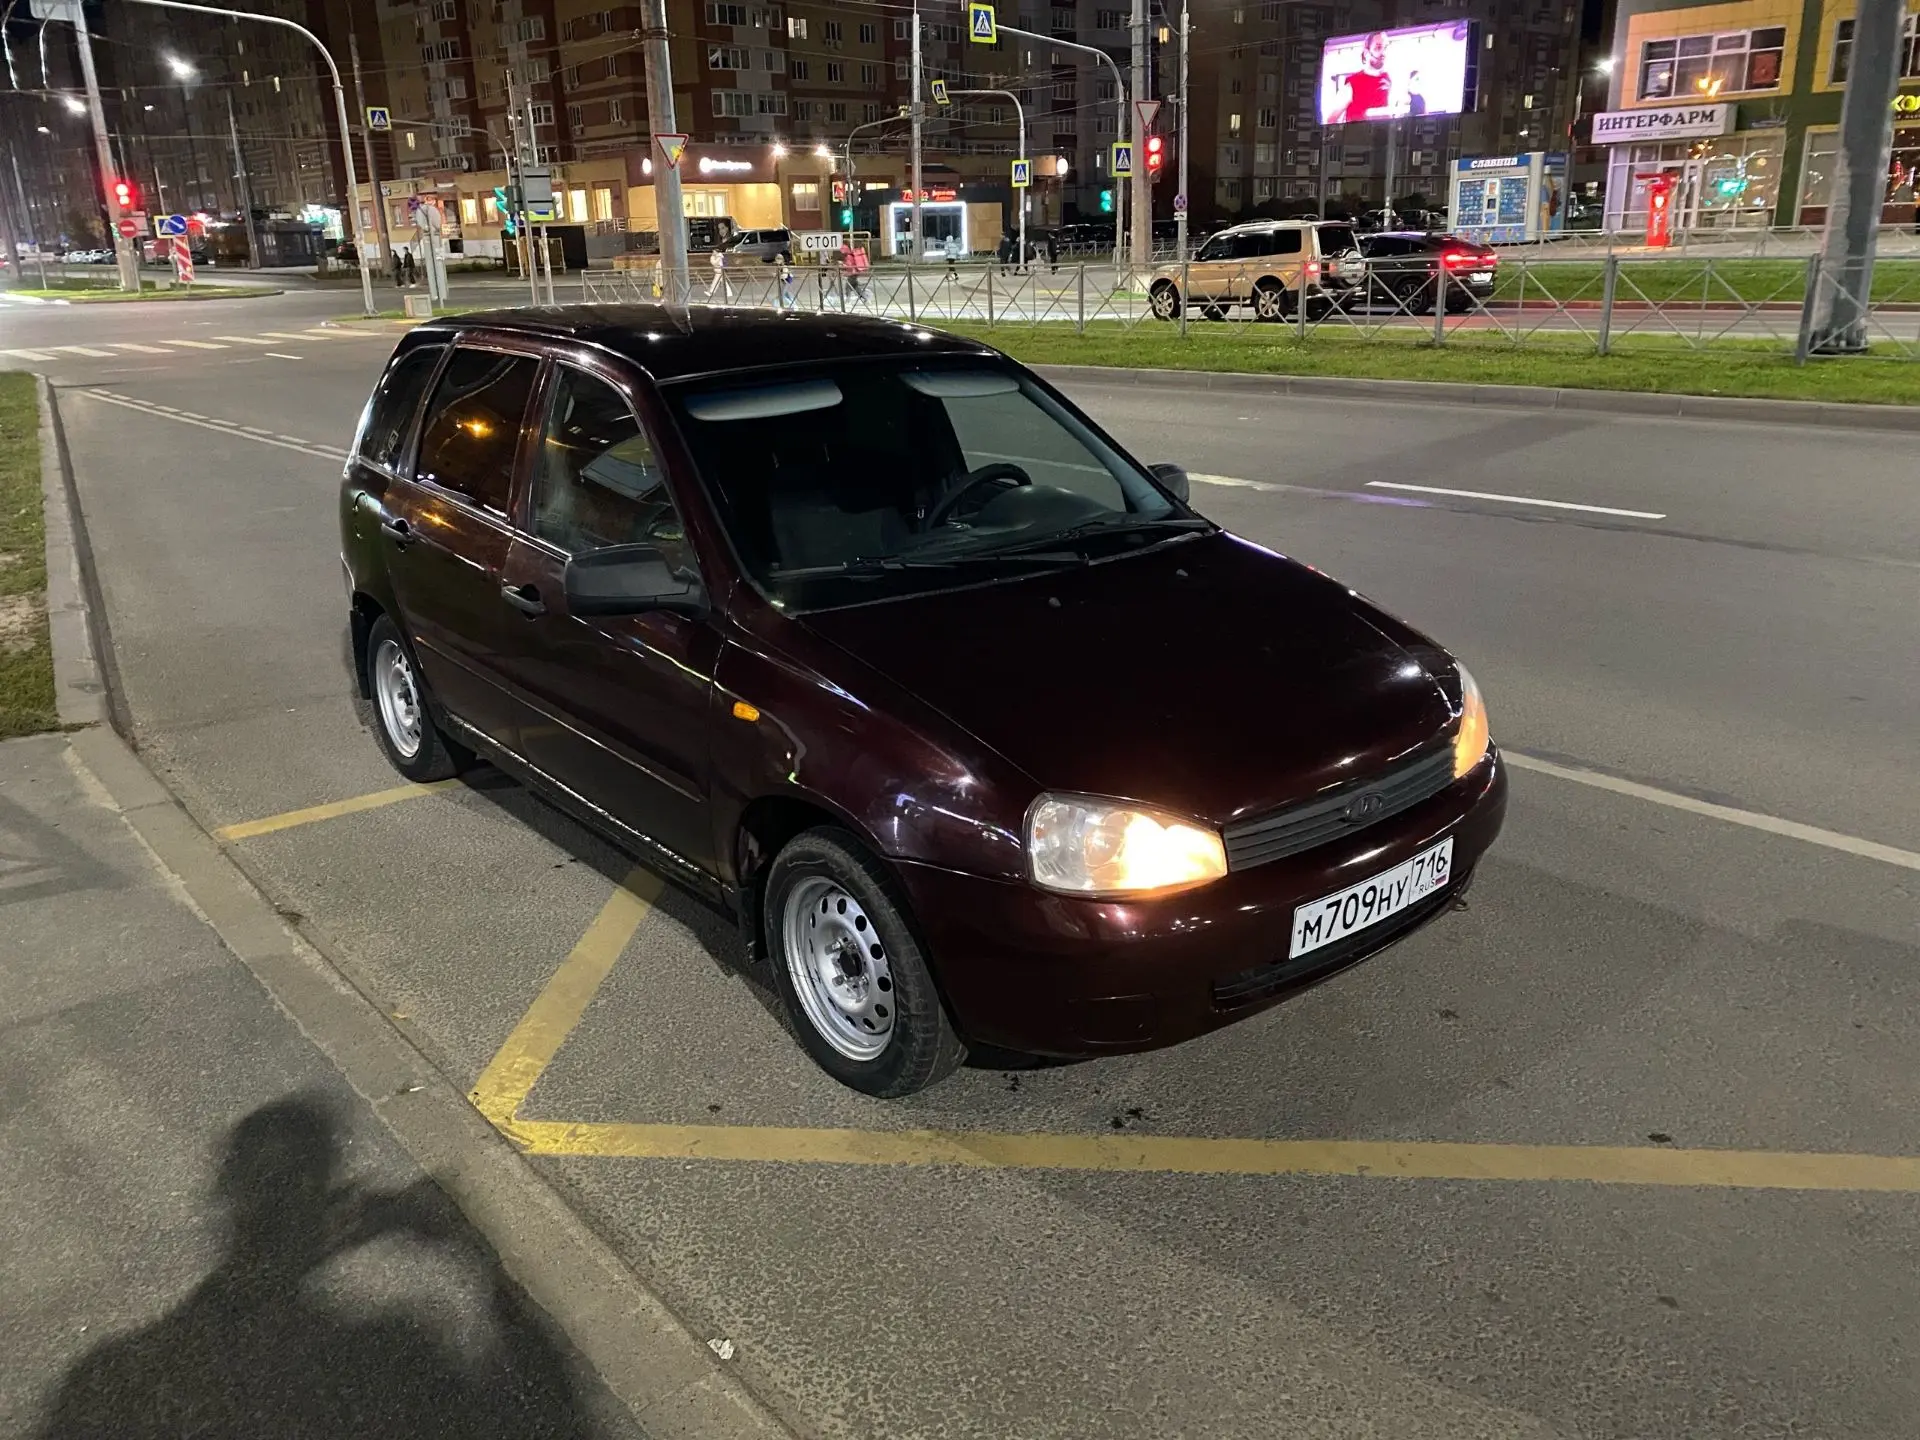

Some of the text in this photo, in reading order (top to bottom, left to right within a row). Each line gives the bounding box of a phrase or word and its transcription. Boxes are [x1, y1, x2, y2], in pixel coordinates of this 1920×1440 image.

[1598, 109, 1716, 131] ИНТЕРФАРМ
[806, 235, 838, 248] СТОП
[1419, 879, 1436, 896] RUS
[1301, 846, 1449, 949] М709НУ 716
